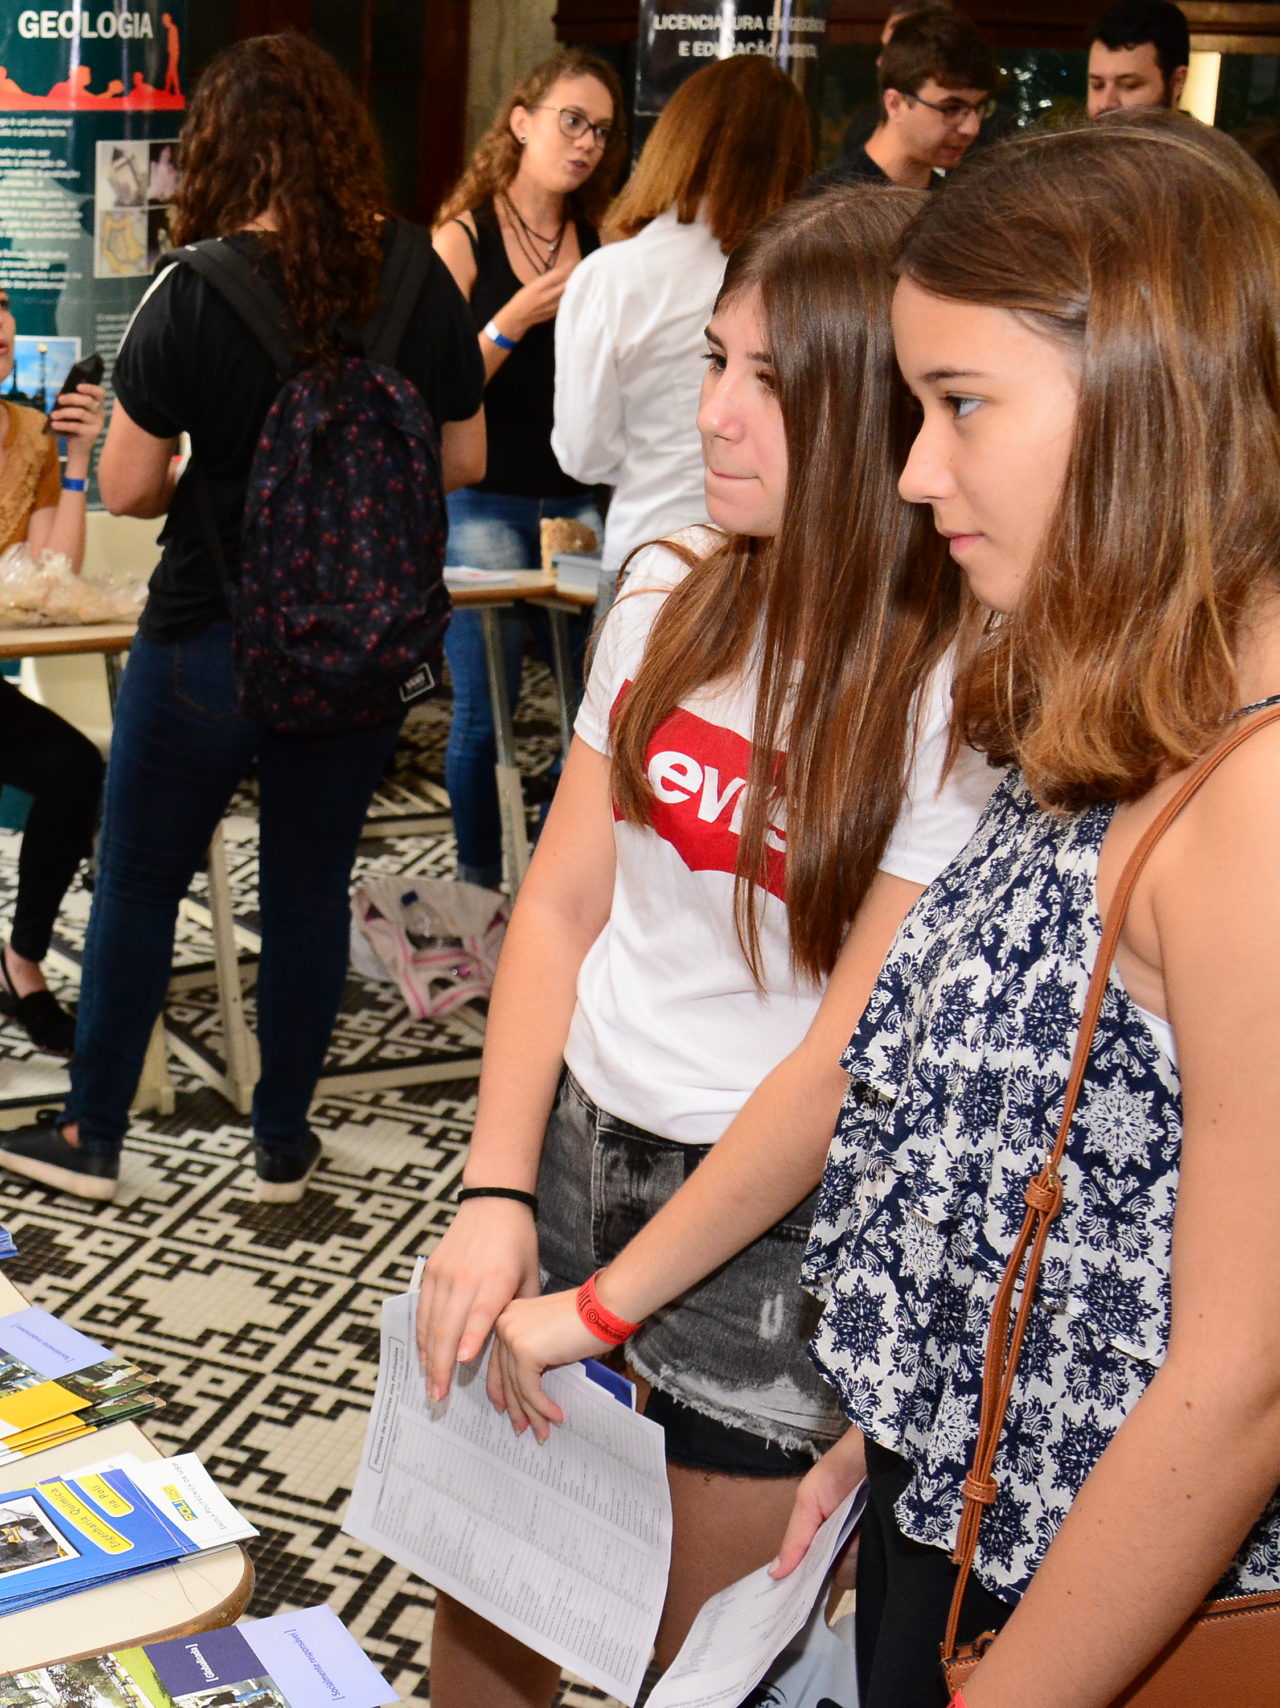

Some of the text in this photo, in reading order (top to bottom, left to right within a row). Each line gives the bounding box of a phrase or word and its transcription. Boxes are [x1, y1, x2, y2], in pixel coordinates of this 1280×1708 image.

[18, 11, 153, 39] GEOLOGIA
[654, 14, 763, 31] LICENCIAURA
[92, 1484, 120, 1509] na Poli
[50, 1487, 121, 1549] Engenharia Química
[174, 1500, 196, 1520] POLI
[185, 1643, 219, 1682] [Globalizada]
